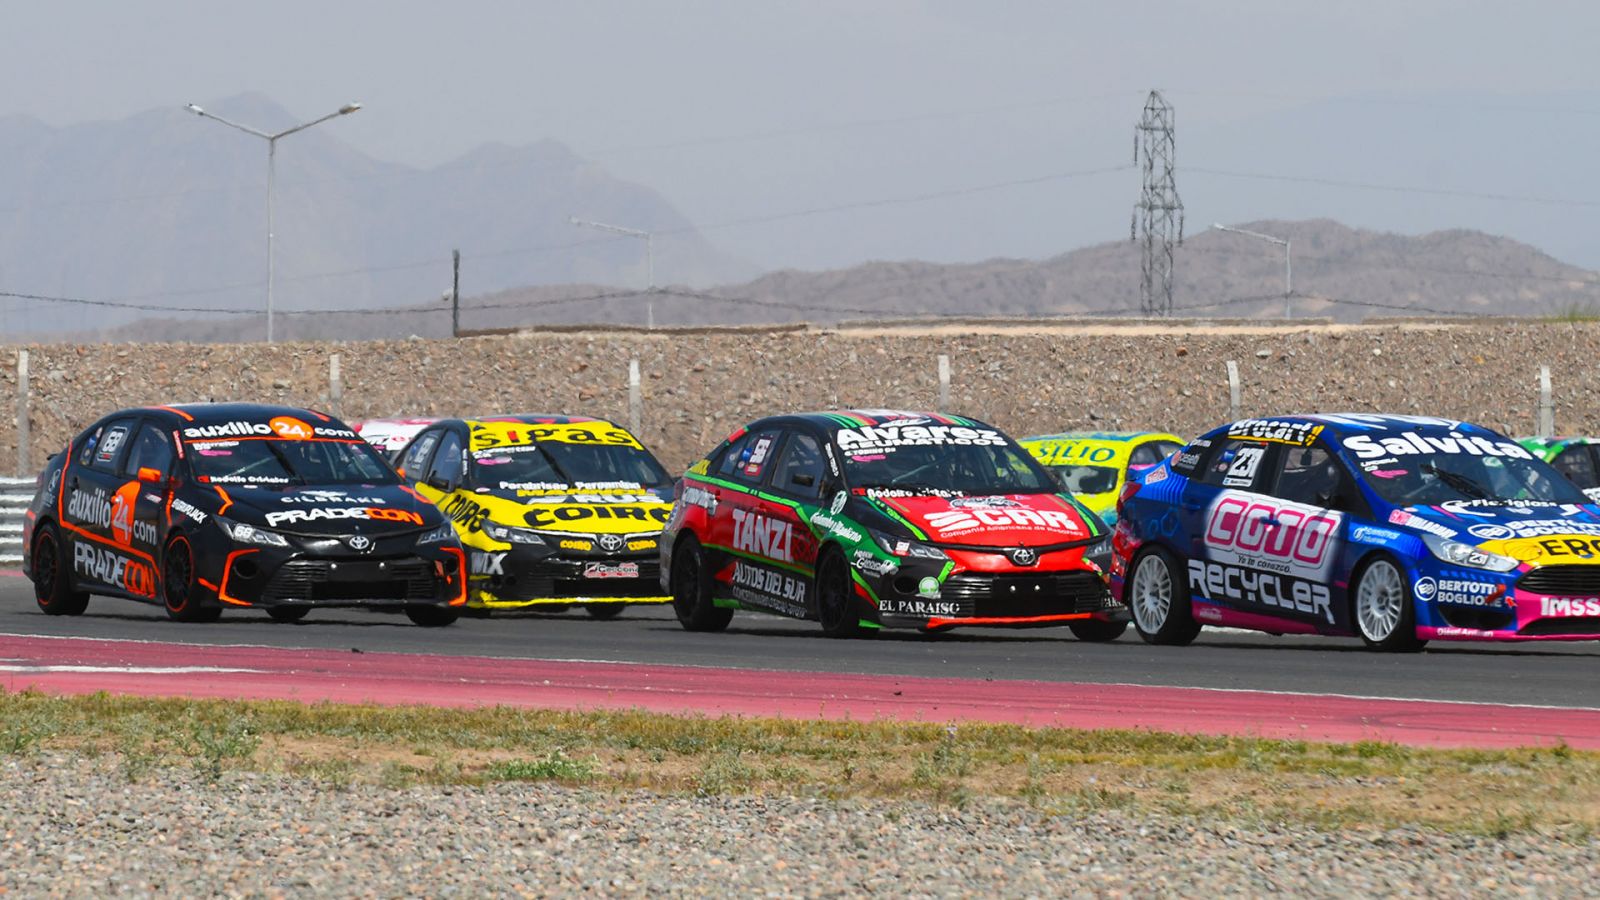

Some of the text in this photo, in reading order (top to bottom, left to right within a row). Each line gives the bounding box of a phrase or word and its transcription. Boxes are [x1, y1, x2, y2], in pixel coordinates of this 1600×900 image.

[837, 425, 1003, 444] Alvarez
[839, 437, 1008, 450] NEUMATICOS
[1343, 432, 1533, 460] Salvita
[265, 507, 424, 528] PRADECON
[1207, 497, 1341, 565] COTO
[732, 507, 794, 563] TANZI
[74, 541, 156, 599] PRADECON
[732, 561, 806, 603] AUTOS DEL SUR
[879, 600, 960, 614] EL PARAISO
